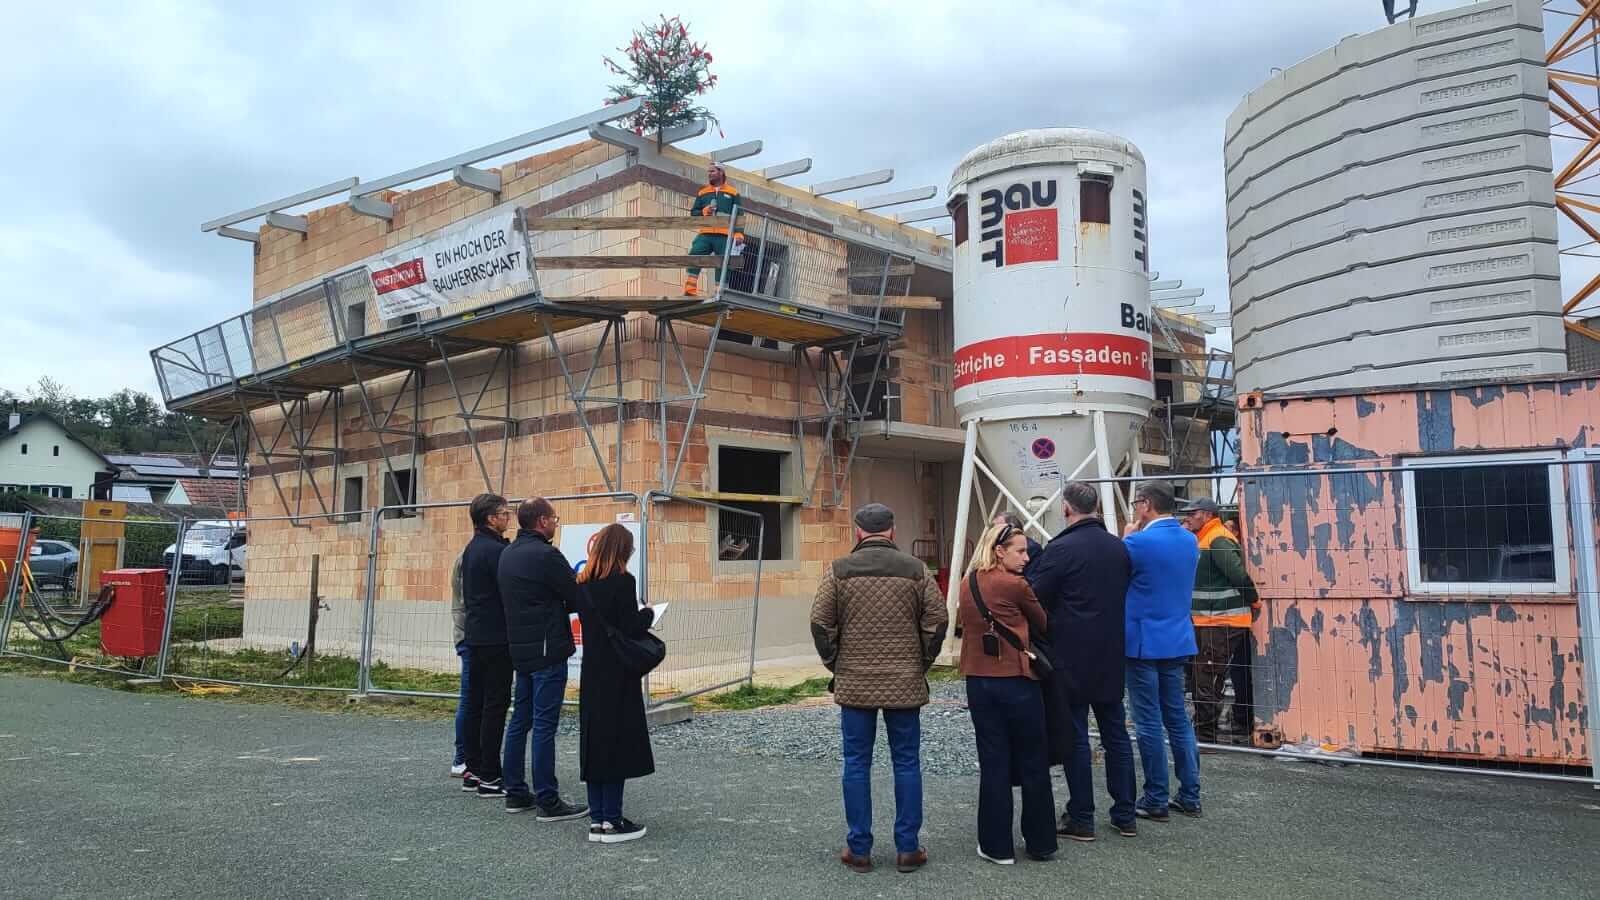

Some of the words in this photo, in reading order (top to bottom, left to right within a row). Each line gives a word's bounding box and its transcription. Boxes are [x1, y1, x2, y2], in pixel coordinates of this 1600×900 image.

[435, 252, 452, 269] EIN
[453, 239, 482, 264] HOCH
[484, 229, 507, 252] DER
[432, 251, 521, 293] BAUHERRSCHAFT
[953, 352, 1006, 379] striche
[1029, 345, 1132, 366] Fassaden
